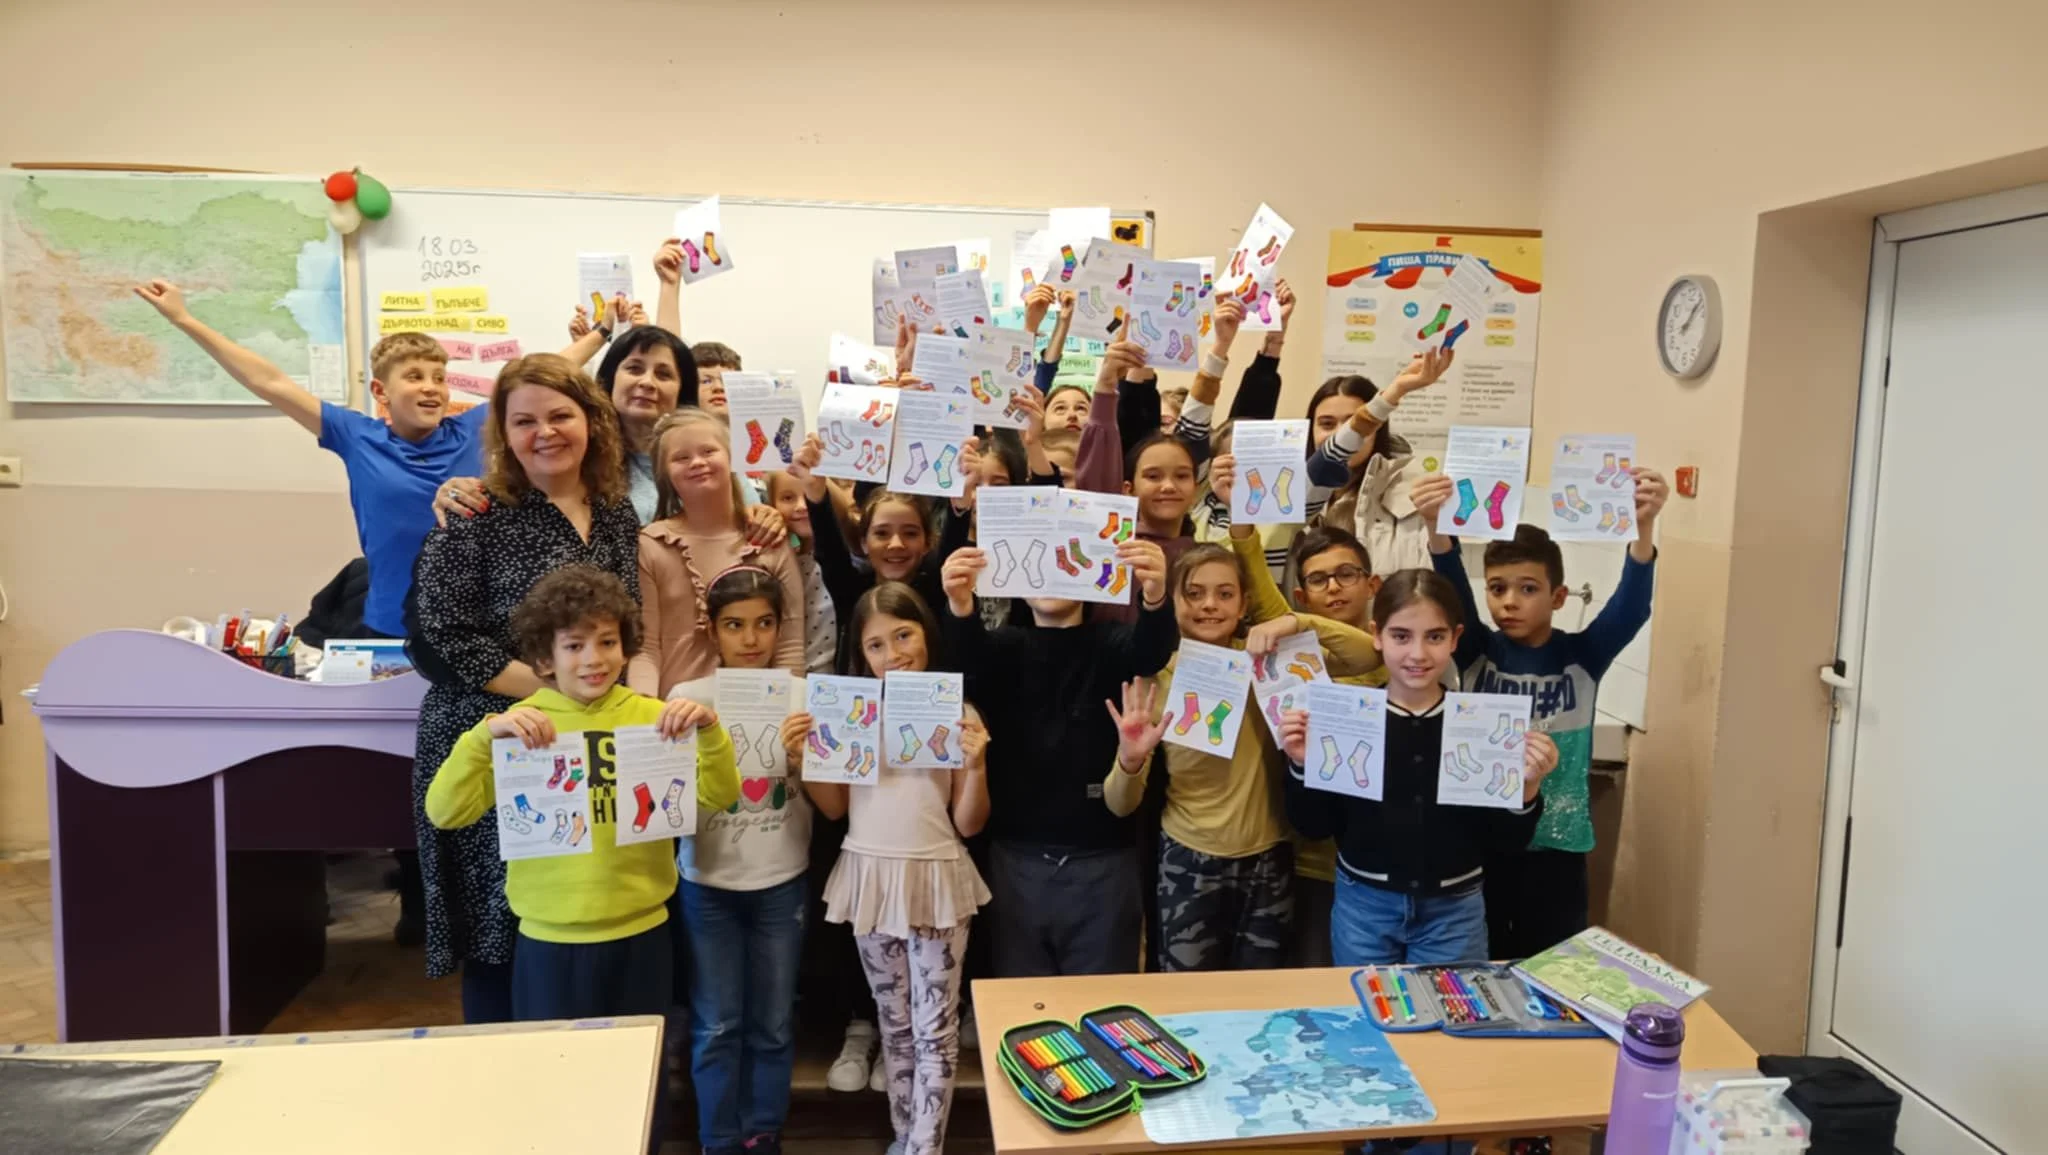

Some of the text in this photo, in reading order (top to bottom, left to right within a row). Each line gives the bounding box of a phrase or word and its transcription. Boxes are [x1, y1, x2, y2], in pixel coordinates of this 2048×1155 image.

[384, 295, 420, 305] ЛИТНА
[435, 318, 460, 328] НАД
[476, 318, 506, 328] СИВО
